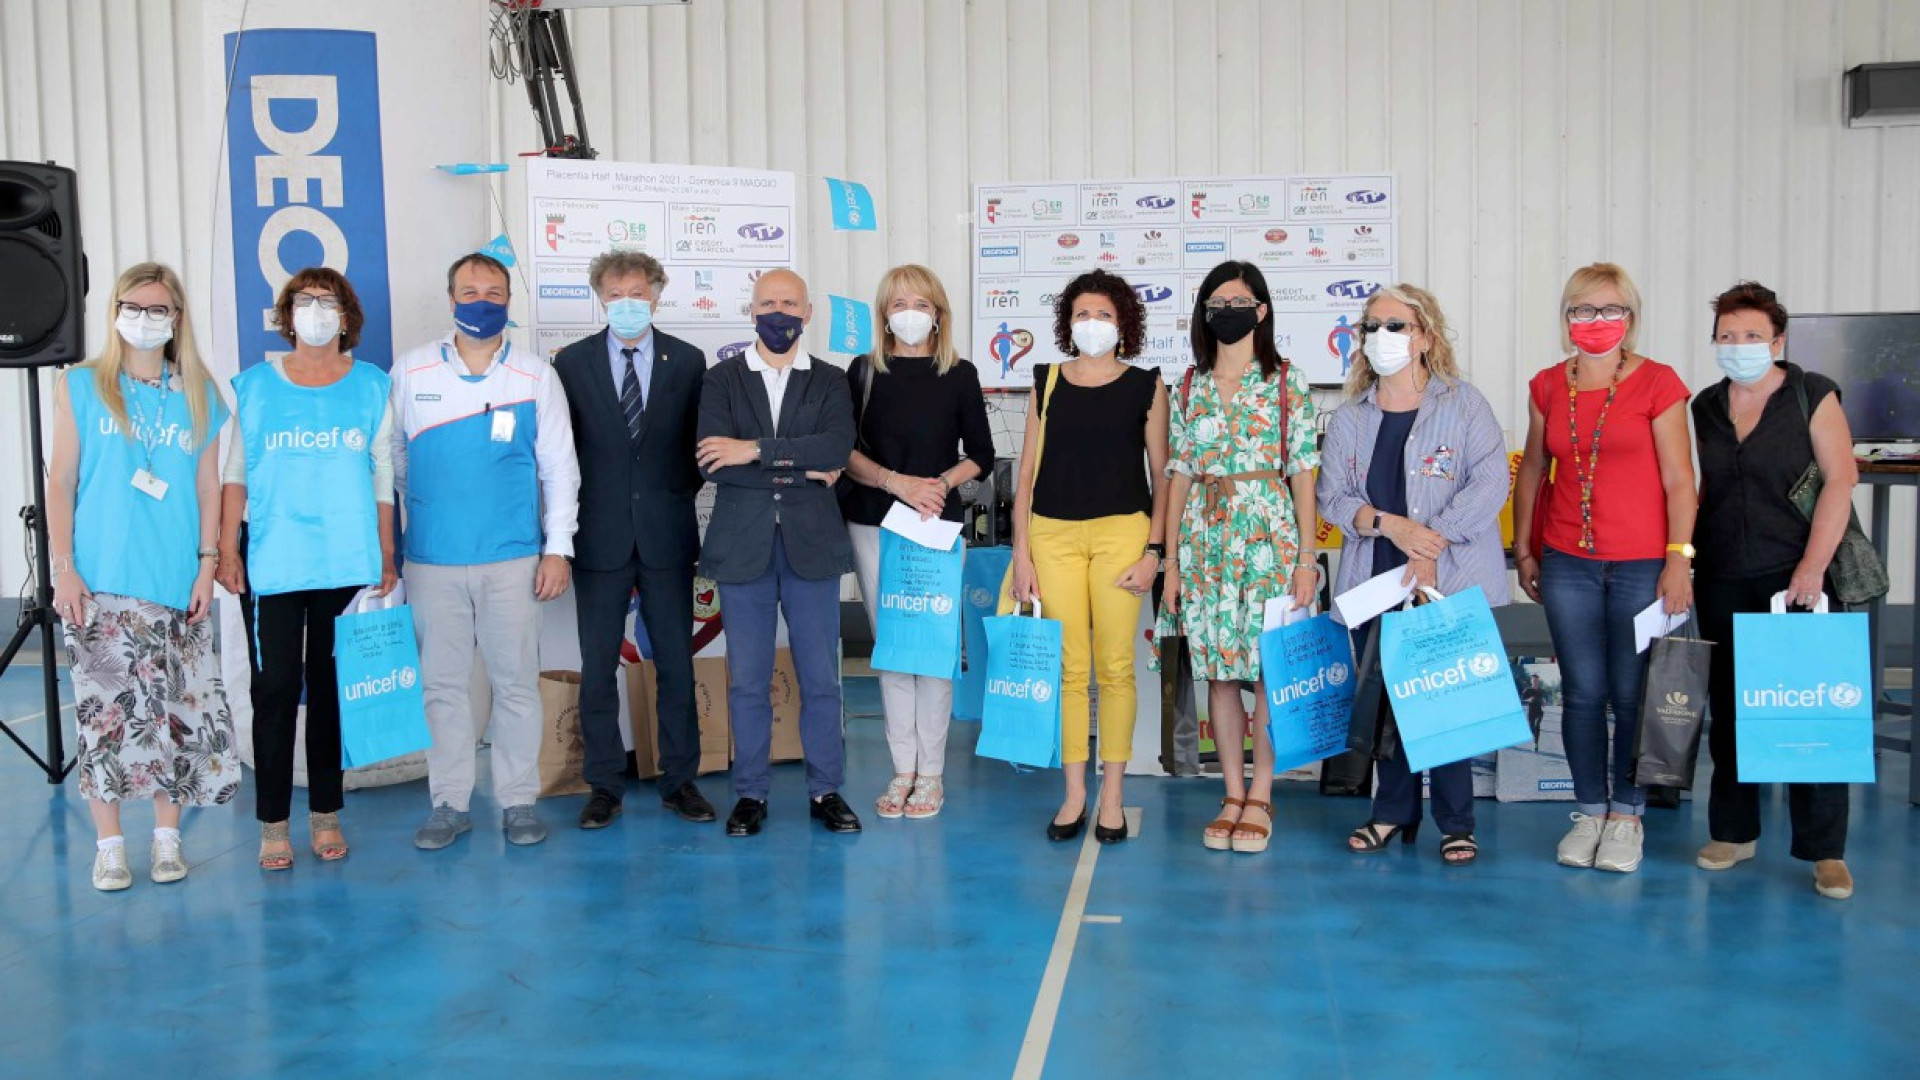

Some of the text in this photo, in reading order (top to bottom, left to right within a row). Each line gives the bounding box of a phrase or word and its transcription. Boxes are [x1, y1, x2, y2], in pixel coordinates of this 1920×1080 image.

[546, 169, 589, 180] Placentia
[591, 171, 610, 181] Half
[615, 172, 657, 184] Marathon
[659, 175, 680, 185] 2021
[688, 176, 731, 187] Domenica
[1092, 195, 1118, 207] iren
[1300, 189, 1327, 202] iren
[683, 220, 716, 235] iren
[541, 287, 589, 297] DECATHLON
[986, 294, 1019, 308] iren
[1145, 336, 1175, 349] Half
[265, 426, 339, 450] unicef
[881, 591, 931, 612] unicef
[345, 669, 398, 701] unicef
[1272, 666, 1326, 706] unicef
[1394, 657, 1468, 699] unicef
[989, 677, 1032, 699] unicef
[1743, 683, 1826, 707] unicef
